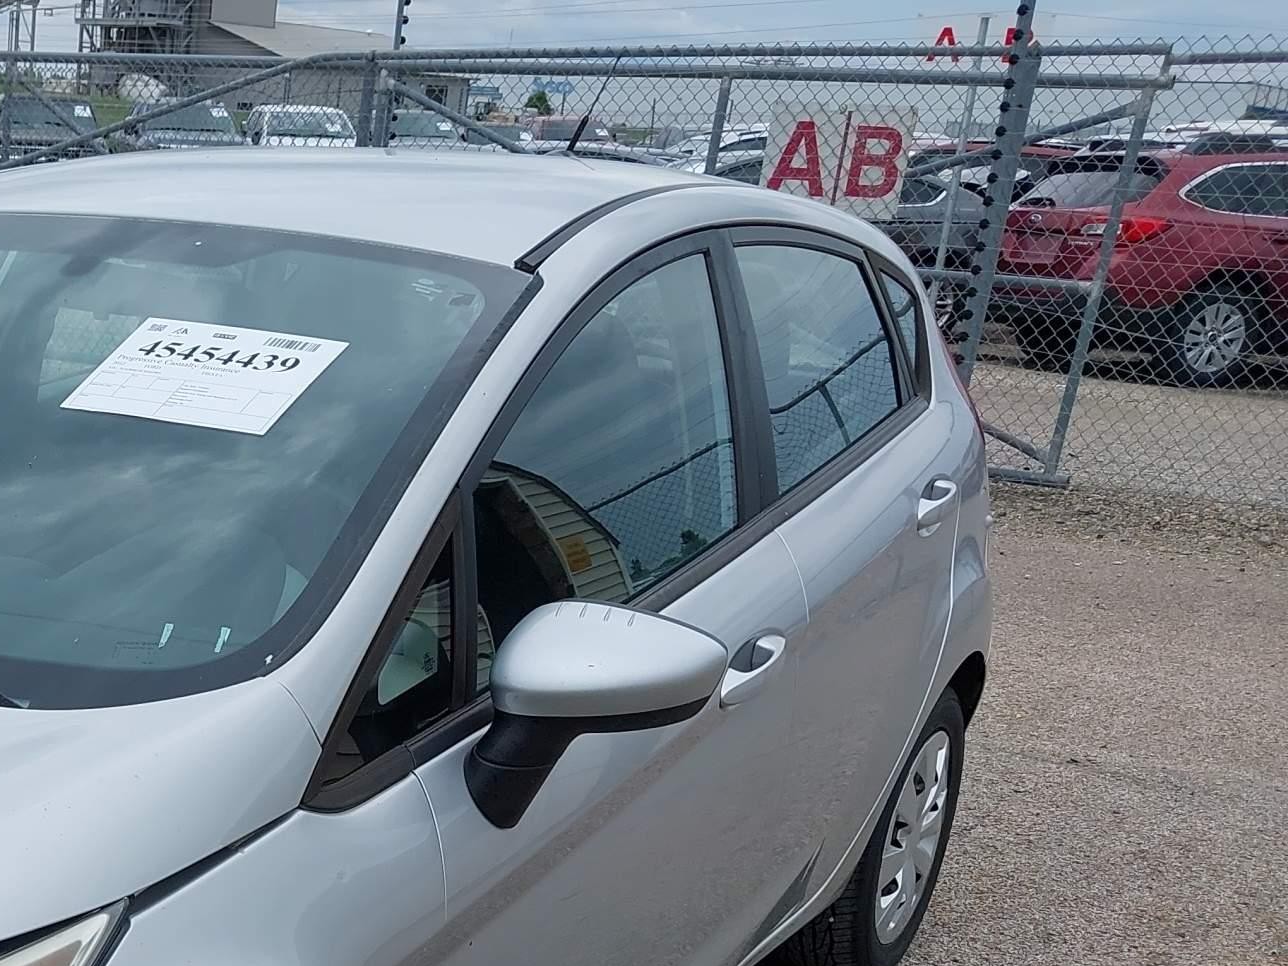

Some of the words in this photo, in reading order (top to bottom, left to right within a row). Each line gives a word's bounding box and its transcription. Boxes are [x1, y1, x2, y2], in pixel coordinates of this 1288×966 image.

[926, 26, 960, 62] A
[767, 121, 824, 197] A
[844, 125, 903, 198] B
[138, 340, 301, 373] 45454439
